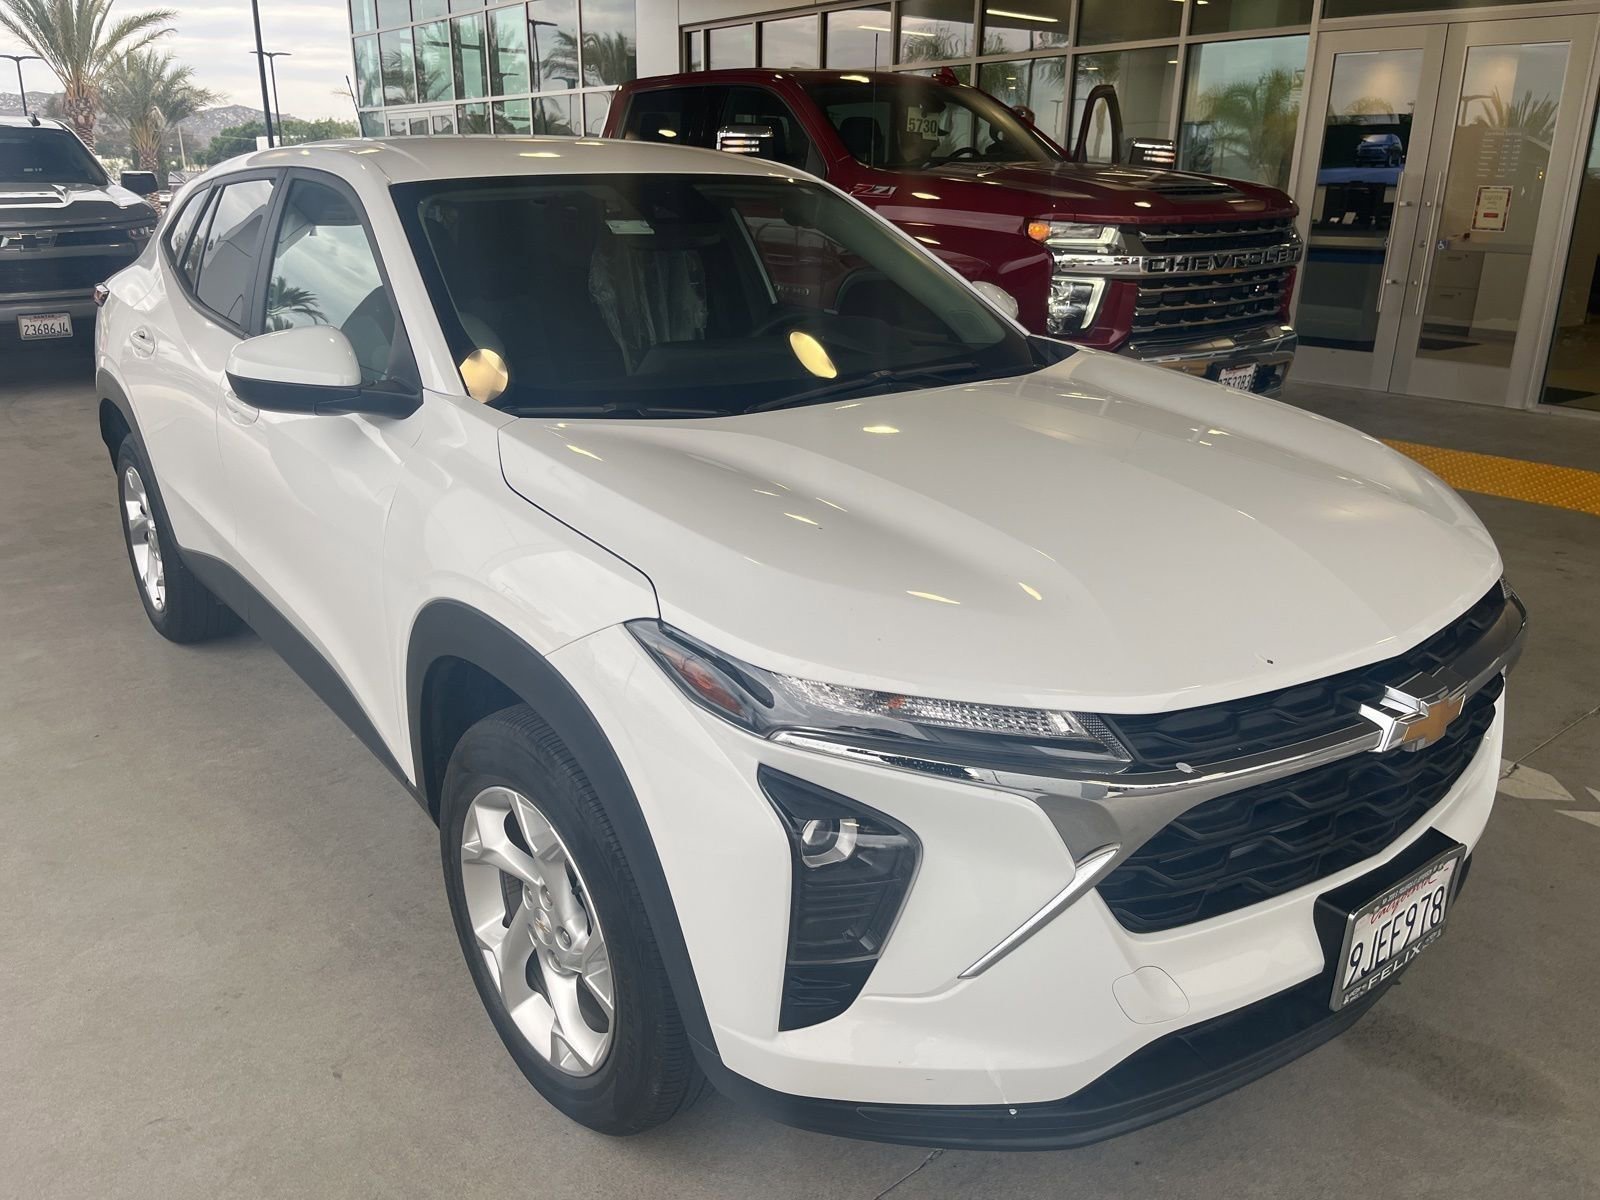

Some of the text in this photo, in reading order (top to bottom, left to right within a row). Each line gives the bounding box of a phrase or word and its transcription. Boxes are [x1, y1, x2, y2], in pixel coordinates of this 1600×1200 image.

[908, 118, 937, 134] 5730
[852, 183, 897, 199] Z71
[1148, 247, 1300, 273] CHEVROLET
[23, 322, 69, 336] 23686J4
[1344, 885, 1445, 990] 9JEF978
[1368, 941, 1422, 990] FELIX
